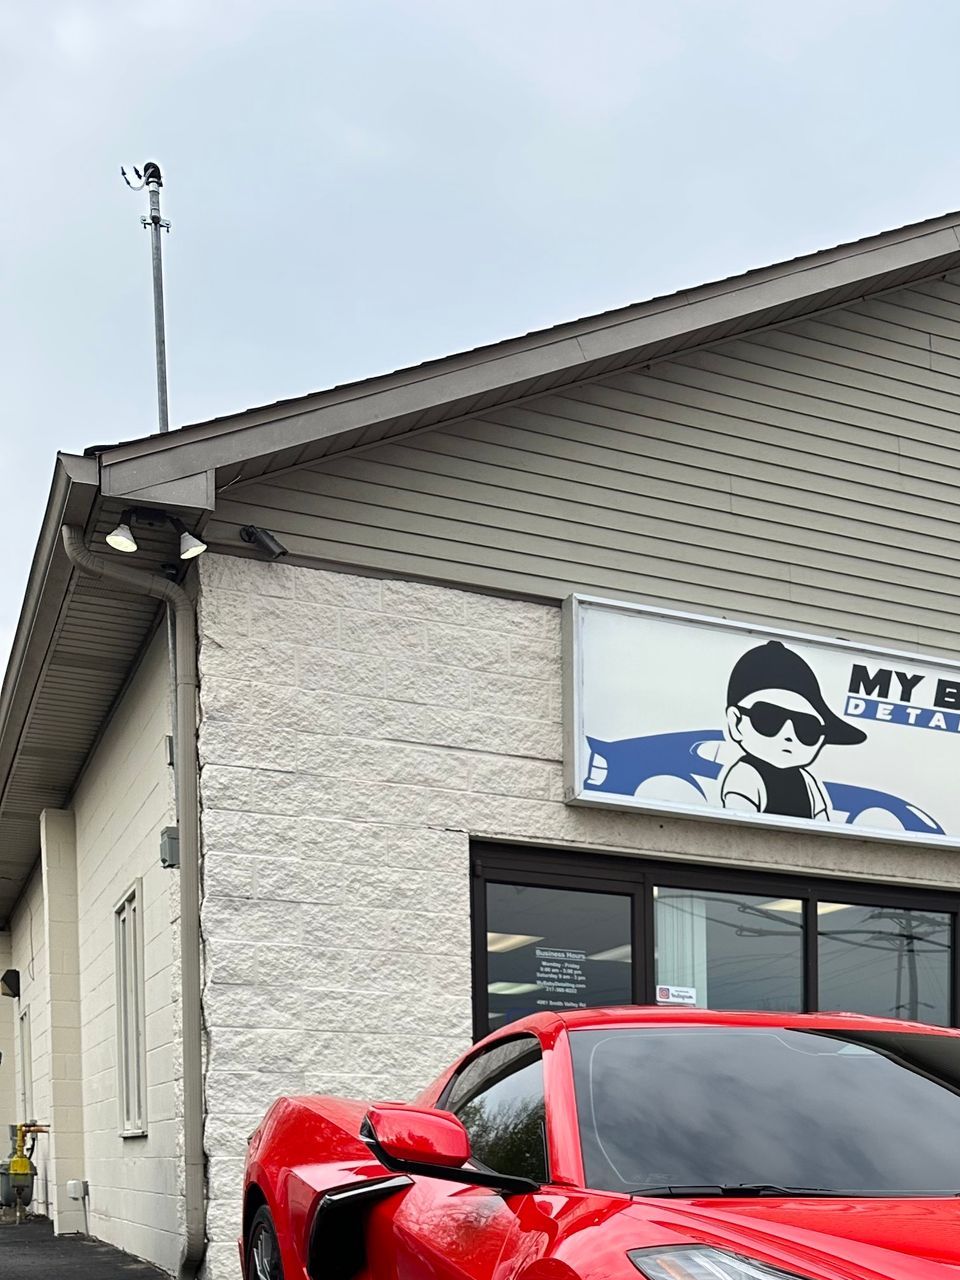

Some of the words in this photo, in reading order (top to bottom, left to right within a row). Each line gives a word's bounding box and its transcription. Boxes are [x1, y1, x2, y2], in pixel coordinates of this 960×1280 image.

[848, 663, 926, 703] MY
[536, 949, 566, 958] Business
[566, 952, 586, 960] Hours
